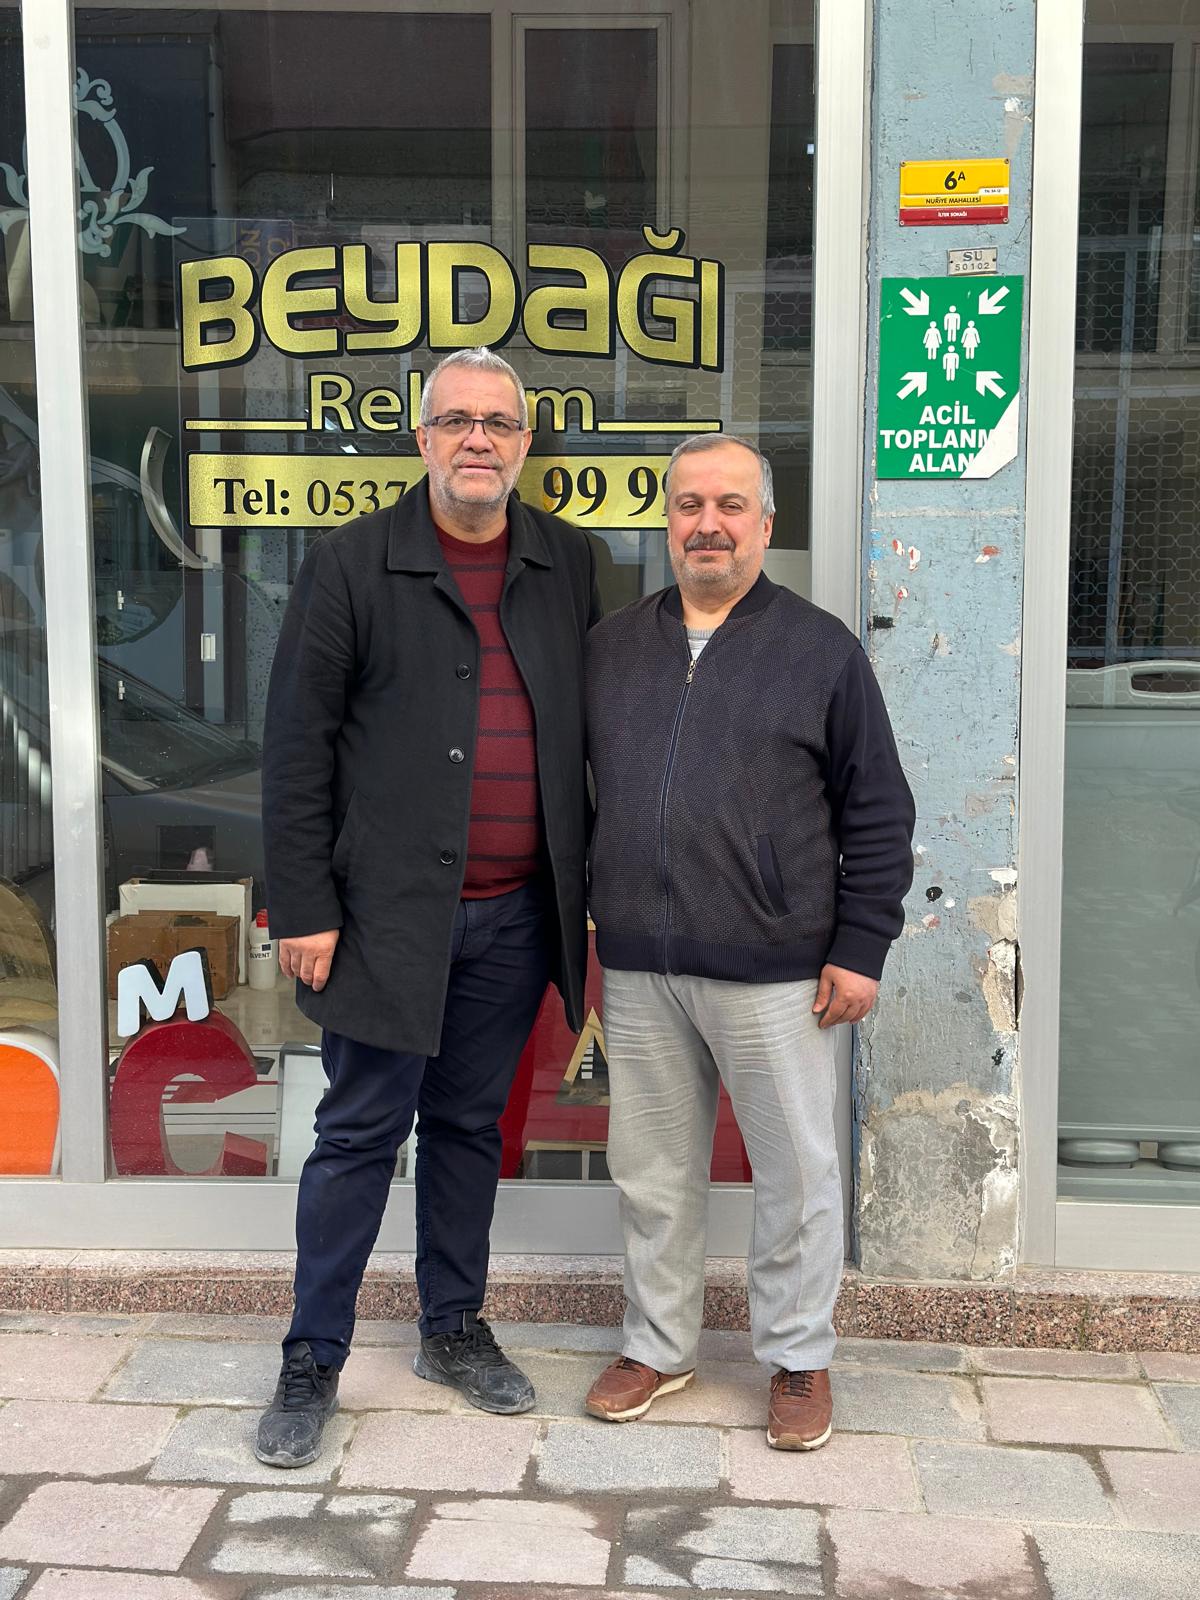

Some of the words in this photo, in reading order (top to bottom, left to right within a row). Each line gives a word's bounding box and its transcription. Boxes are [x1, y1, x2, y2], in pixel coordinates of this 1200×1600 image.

[963, 250, 984, 261] SU
[954, 262, 991, 272] 50102
[307, 370, 597, 434] Rem
[918, 400, 976, 426] ACİL
[879, 428, 996, 450] TOPLANM
[908, 453, 975, 473] ALAN
[213, 478, 290, 516] Tel:
[542, 466, 608, 517] 99
[627, 466, 669, 517] 9
